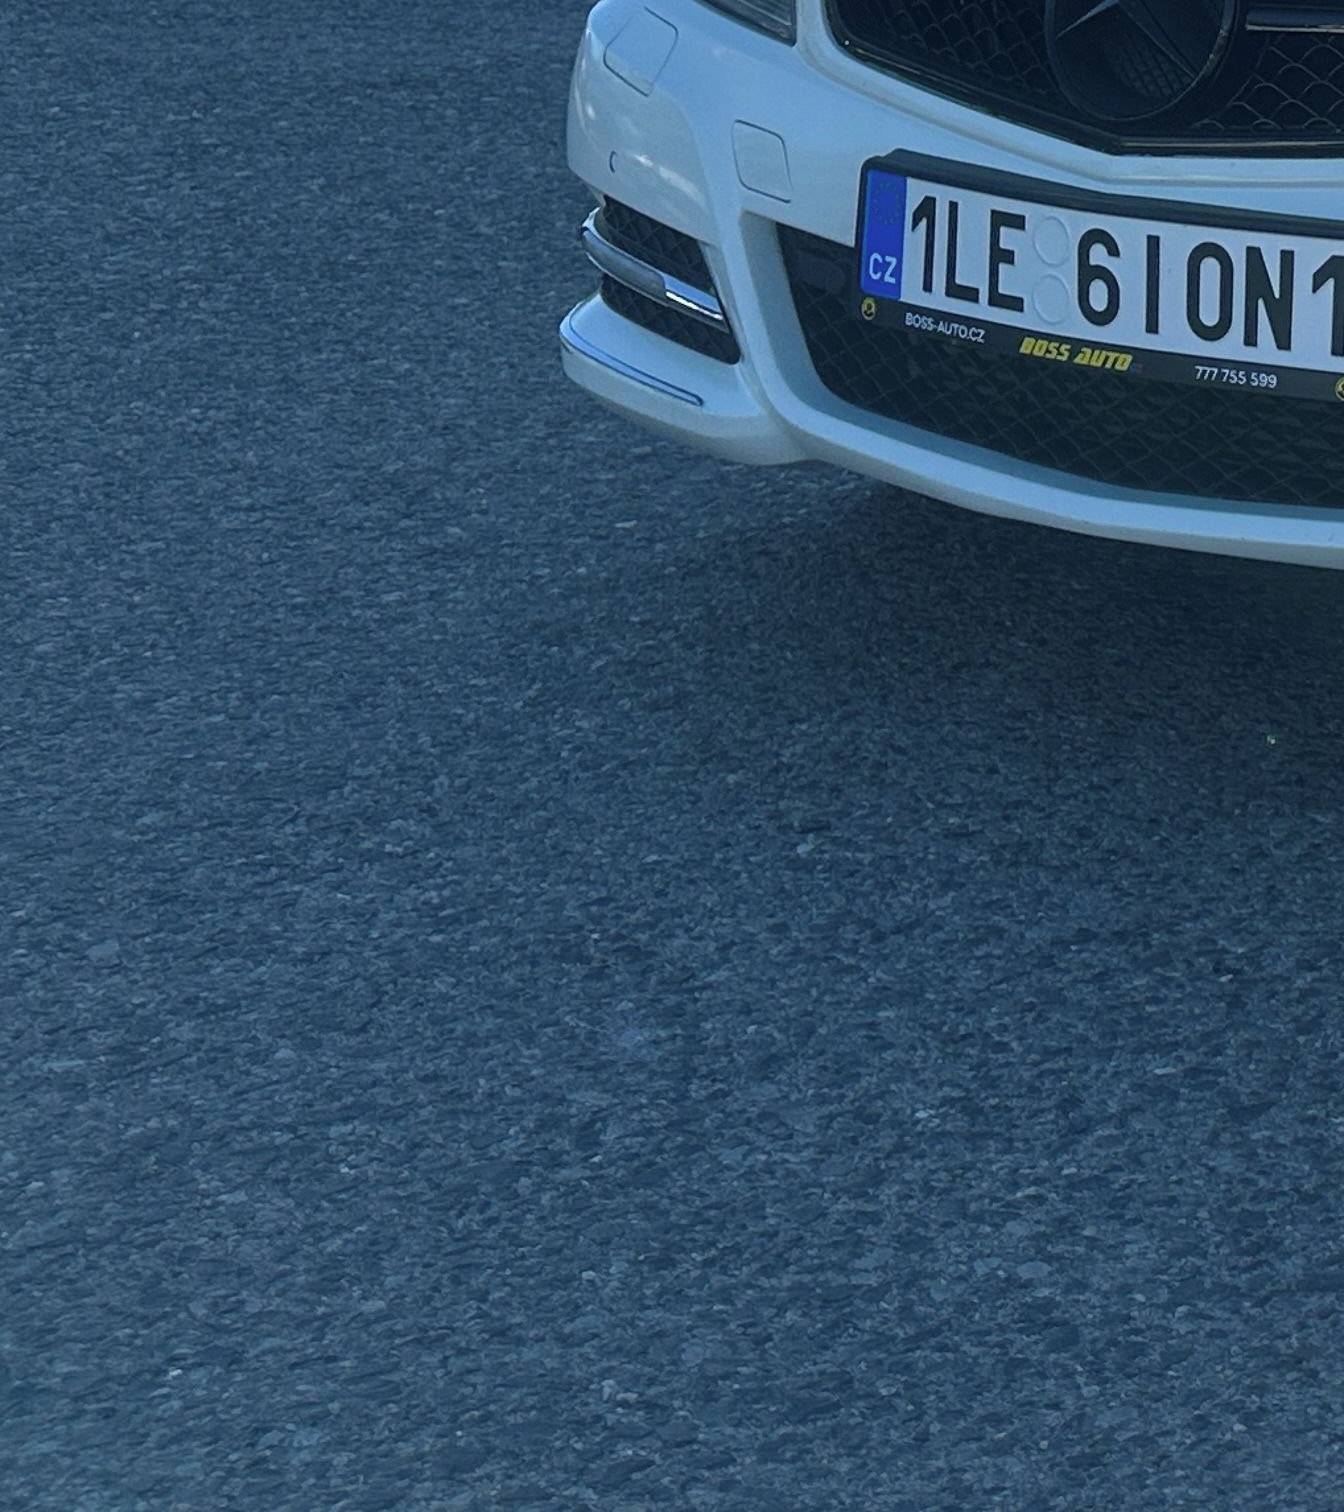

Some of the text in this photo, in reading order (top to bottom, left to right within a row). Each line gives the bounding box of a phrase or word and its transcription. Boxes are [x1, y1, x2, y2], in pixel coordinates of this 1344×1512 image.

[869, 253, 898, 284] CZ
[911, 196, 1026, 313] 1LE
[905, 312, 986, 343] BOSS-AUTO.CZ
[1019, 337, 1071, 362] BOSS
[1073, 347, 1133, 372] AUTO
[1194, 366, 1277, 389] 777 755 599
